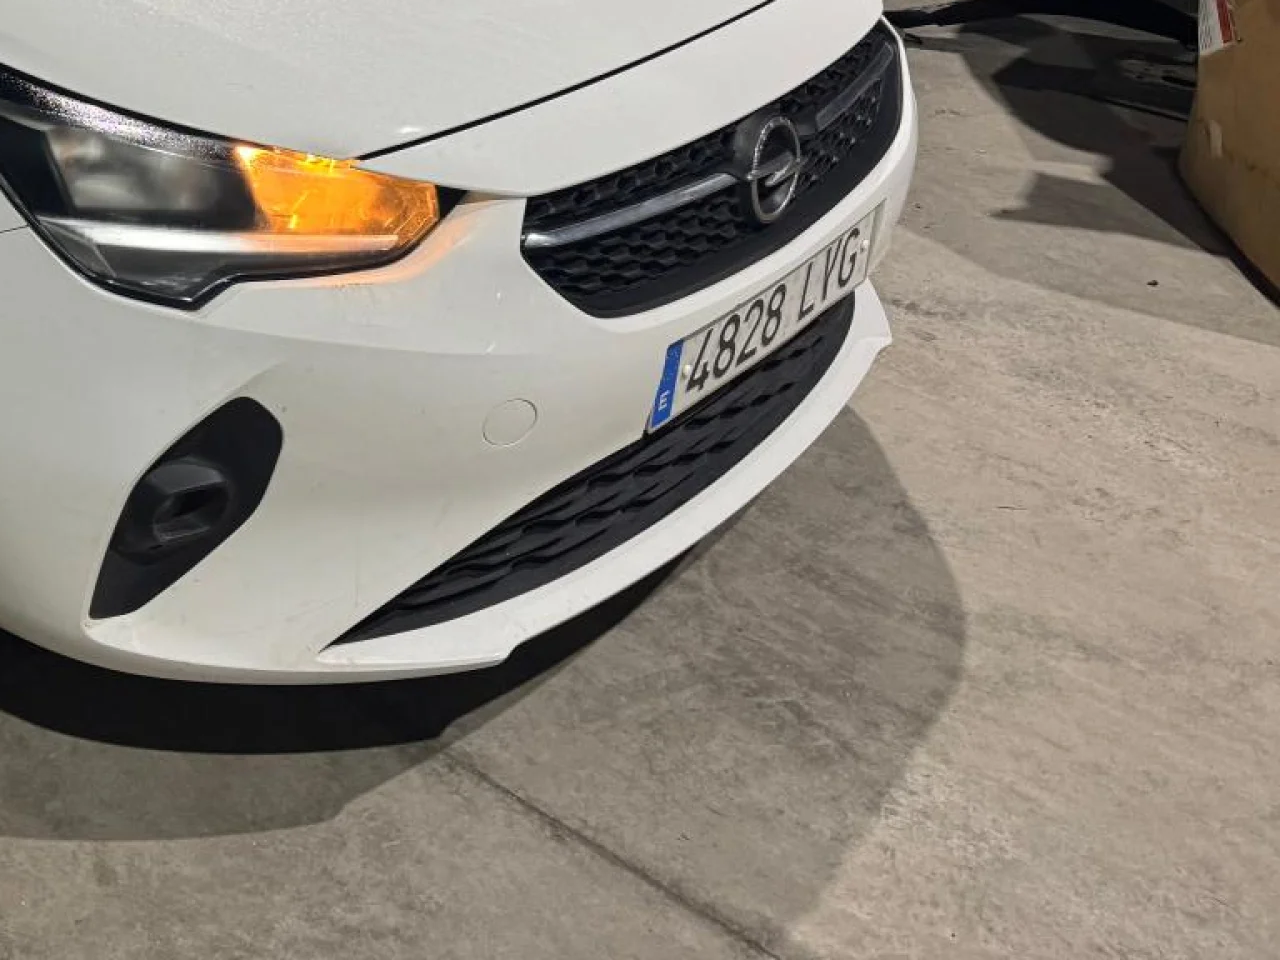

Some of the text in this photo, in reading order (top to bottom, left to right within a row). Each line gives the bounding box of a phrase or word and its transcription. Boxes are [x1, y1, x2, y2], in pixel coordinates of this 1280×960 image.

[657, 227, 860, 411] E 4828 LYG
